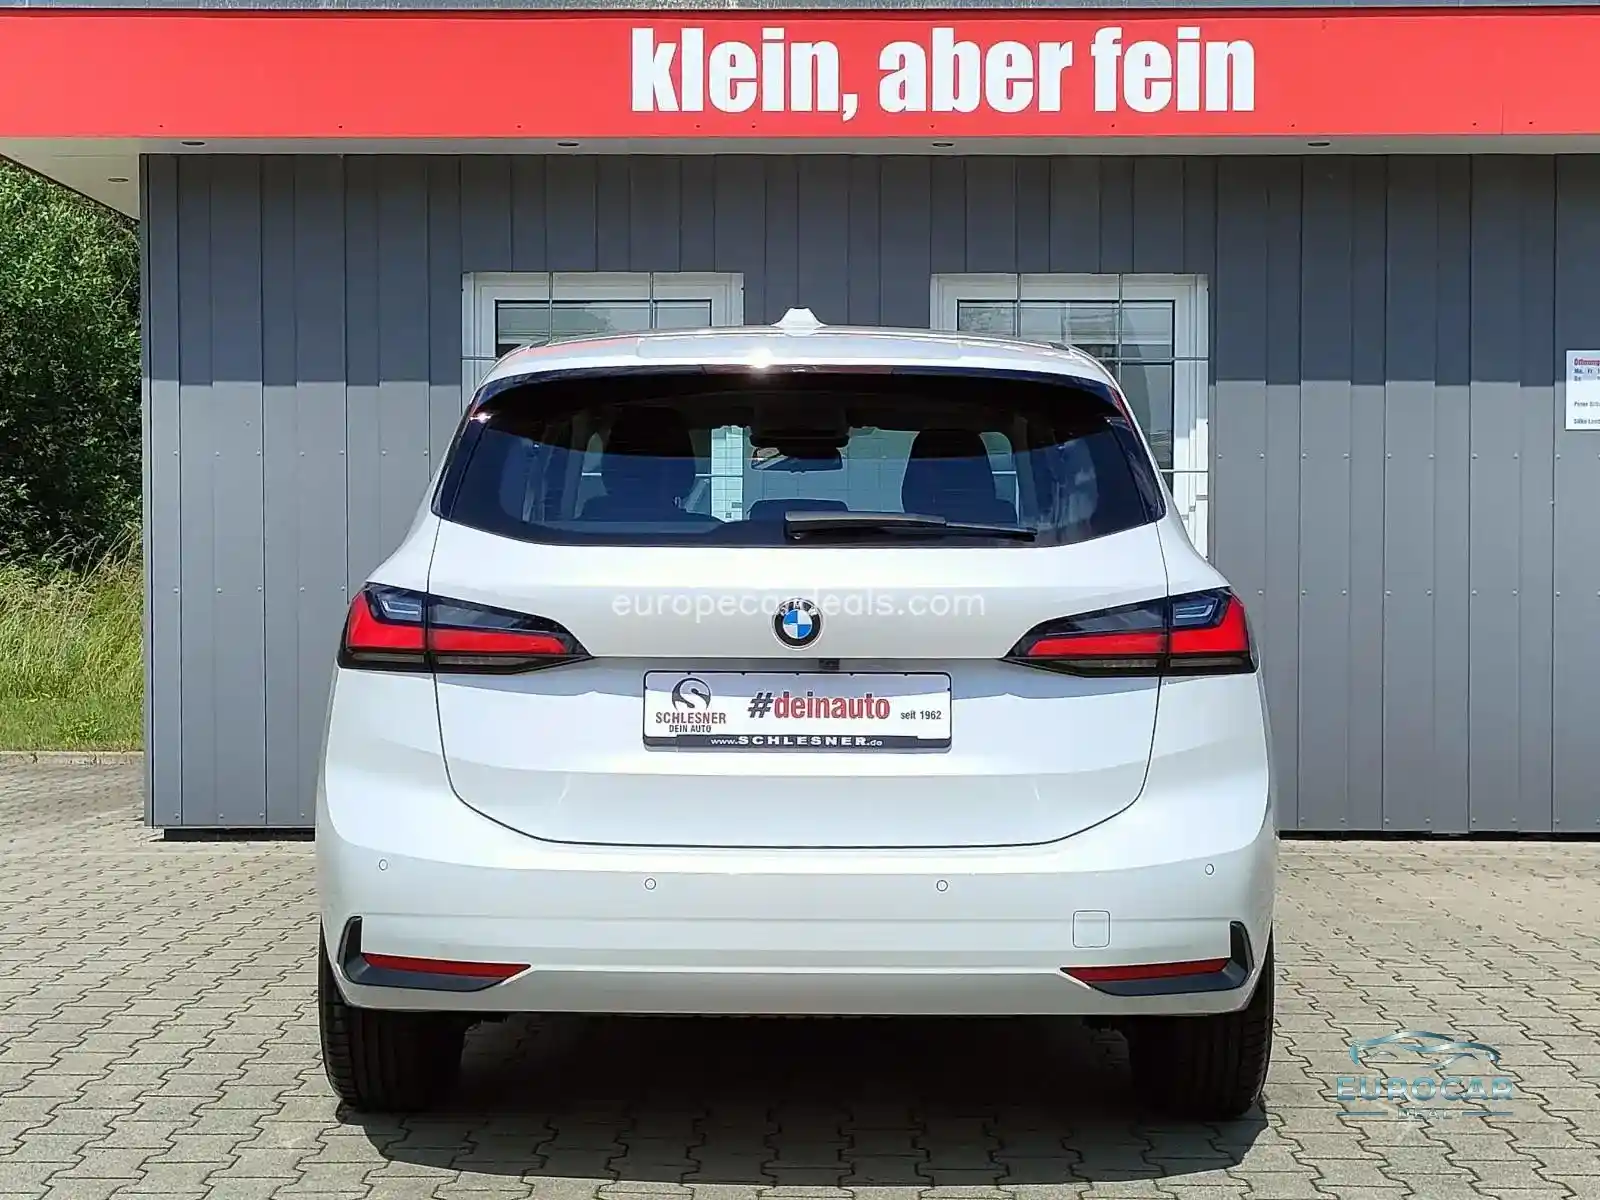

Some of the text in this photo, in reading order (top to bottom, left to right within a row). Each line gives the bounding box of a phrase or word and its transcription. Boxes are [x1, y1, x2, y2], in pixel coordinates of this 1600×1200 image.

[631, 26, 1255, 122] klein, aber fein
[747, 691, 891, 720] #deinauto
[655, 711, 727, 725] SCHLESNER
[900, 710, 942, 720] seit 1962
[668, 724, 712, 733] DEIN AUTO
[710, 735, 883, 747] www.SCHLESNER.de
